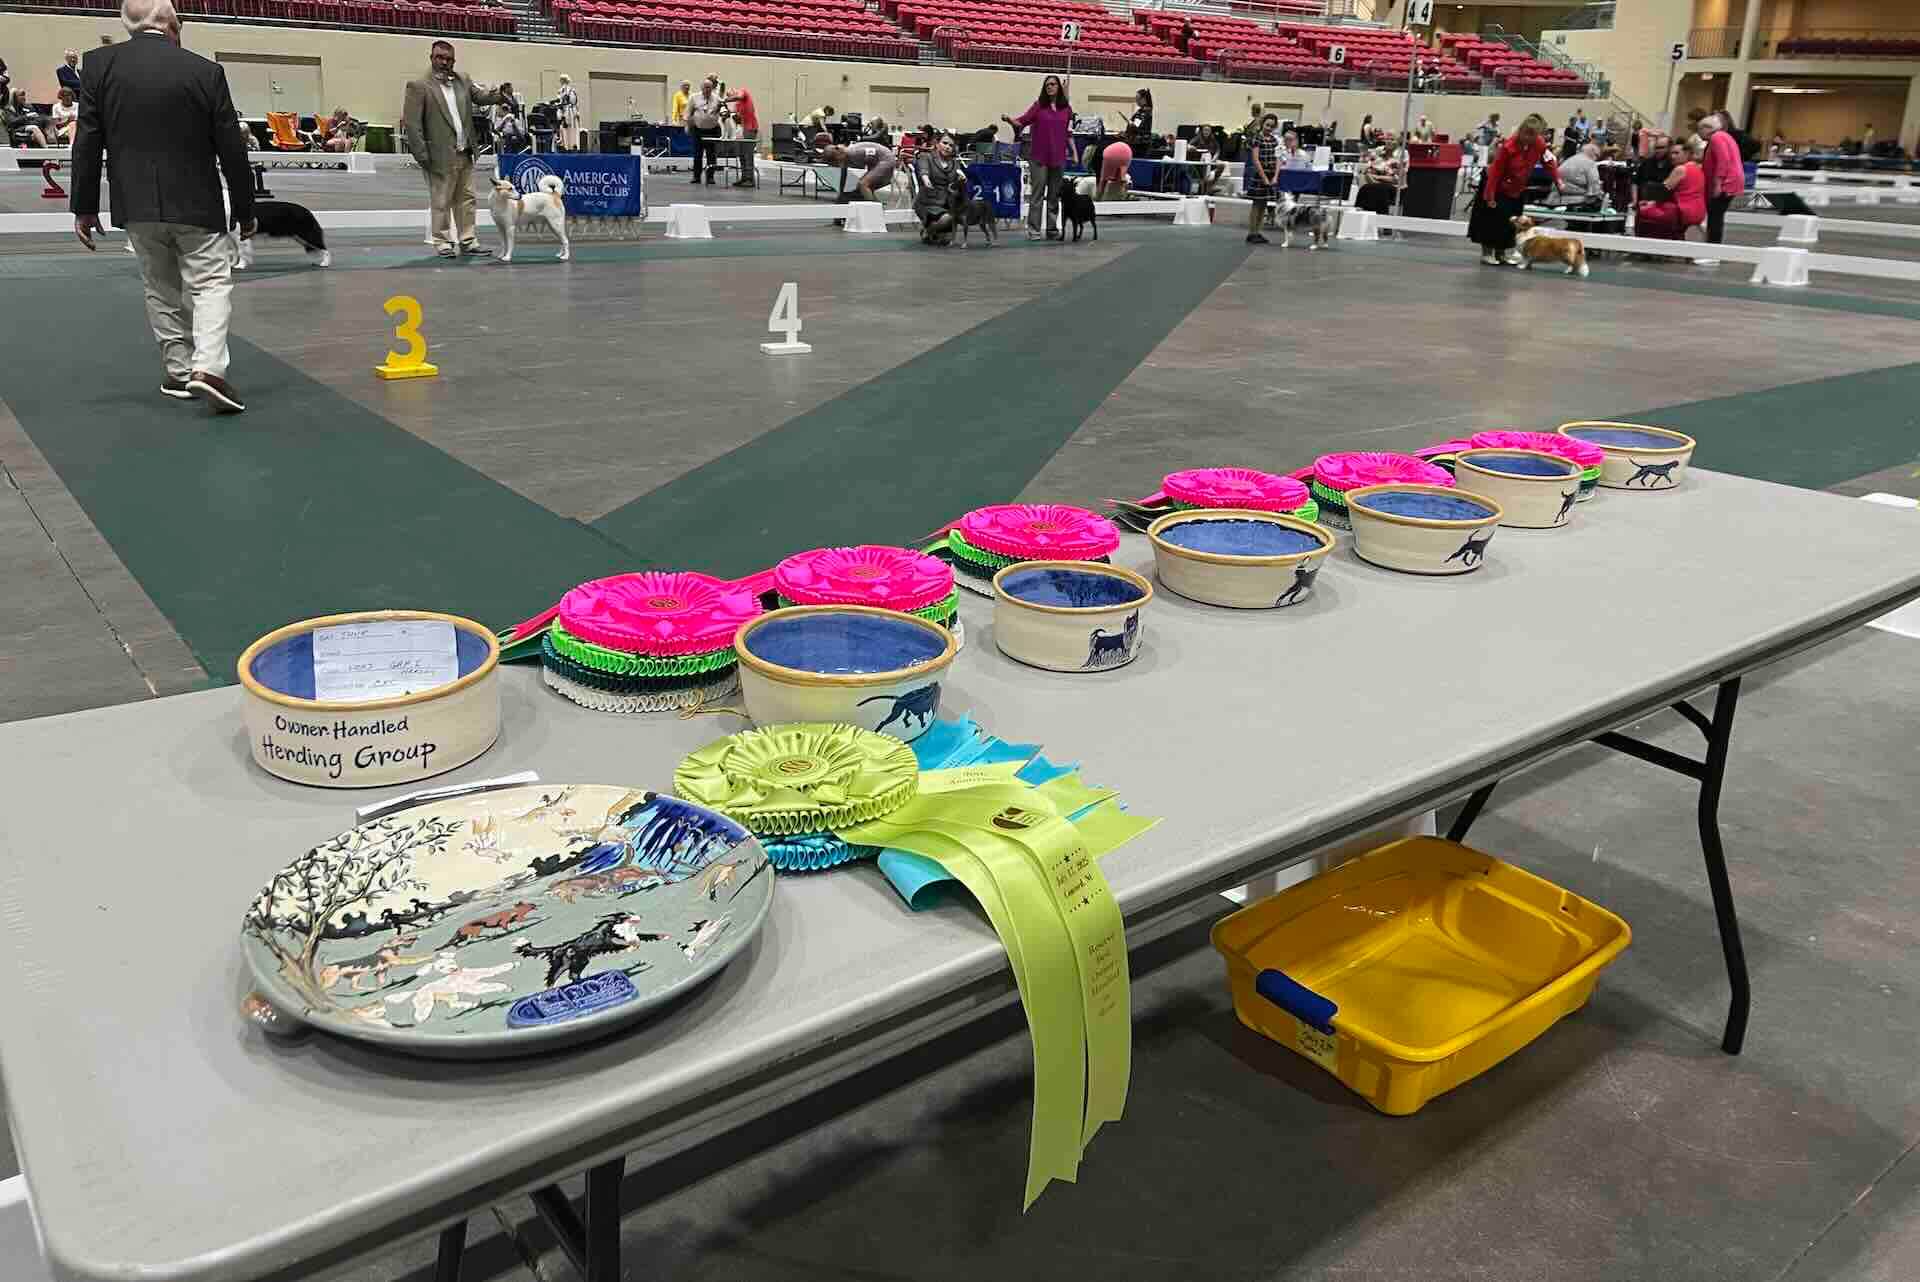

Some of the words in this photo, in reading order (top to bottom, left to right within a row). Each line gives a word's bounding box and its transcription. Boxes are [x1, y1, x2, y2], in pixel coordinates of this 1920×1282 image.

[1421, 1, 1430, 22] 4
[1063, 23, 1072, 40] 2
[1335, 47, 1343, 61] 6
[1671, 43, 1684, 60] 5
[562, 168, 628, 185] AMERICAN
[602, 185, 630, 198] CLUB
[973, 185, 984, 200] 2
[993, 186, 1001, 203] 1
[768, 282, 802, 346] 4
[383, 295, 428, 367] 3
[332, 715, 410, 740] Handled
[262, 735, 343, 779] Herding
[354, 742, 437, 769] Group
